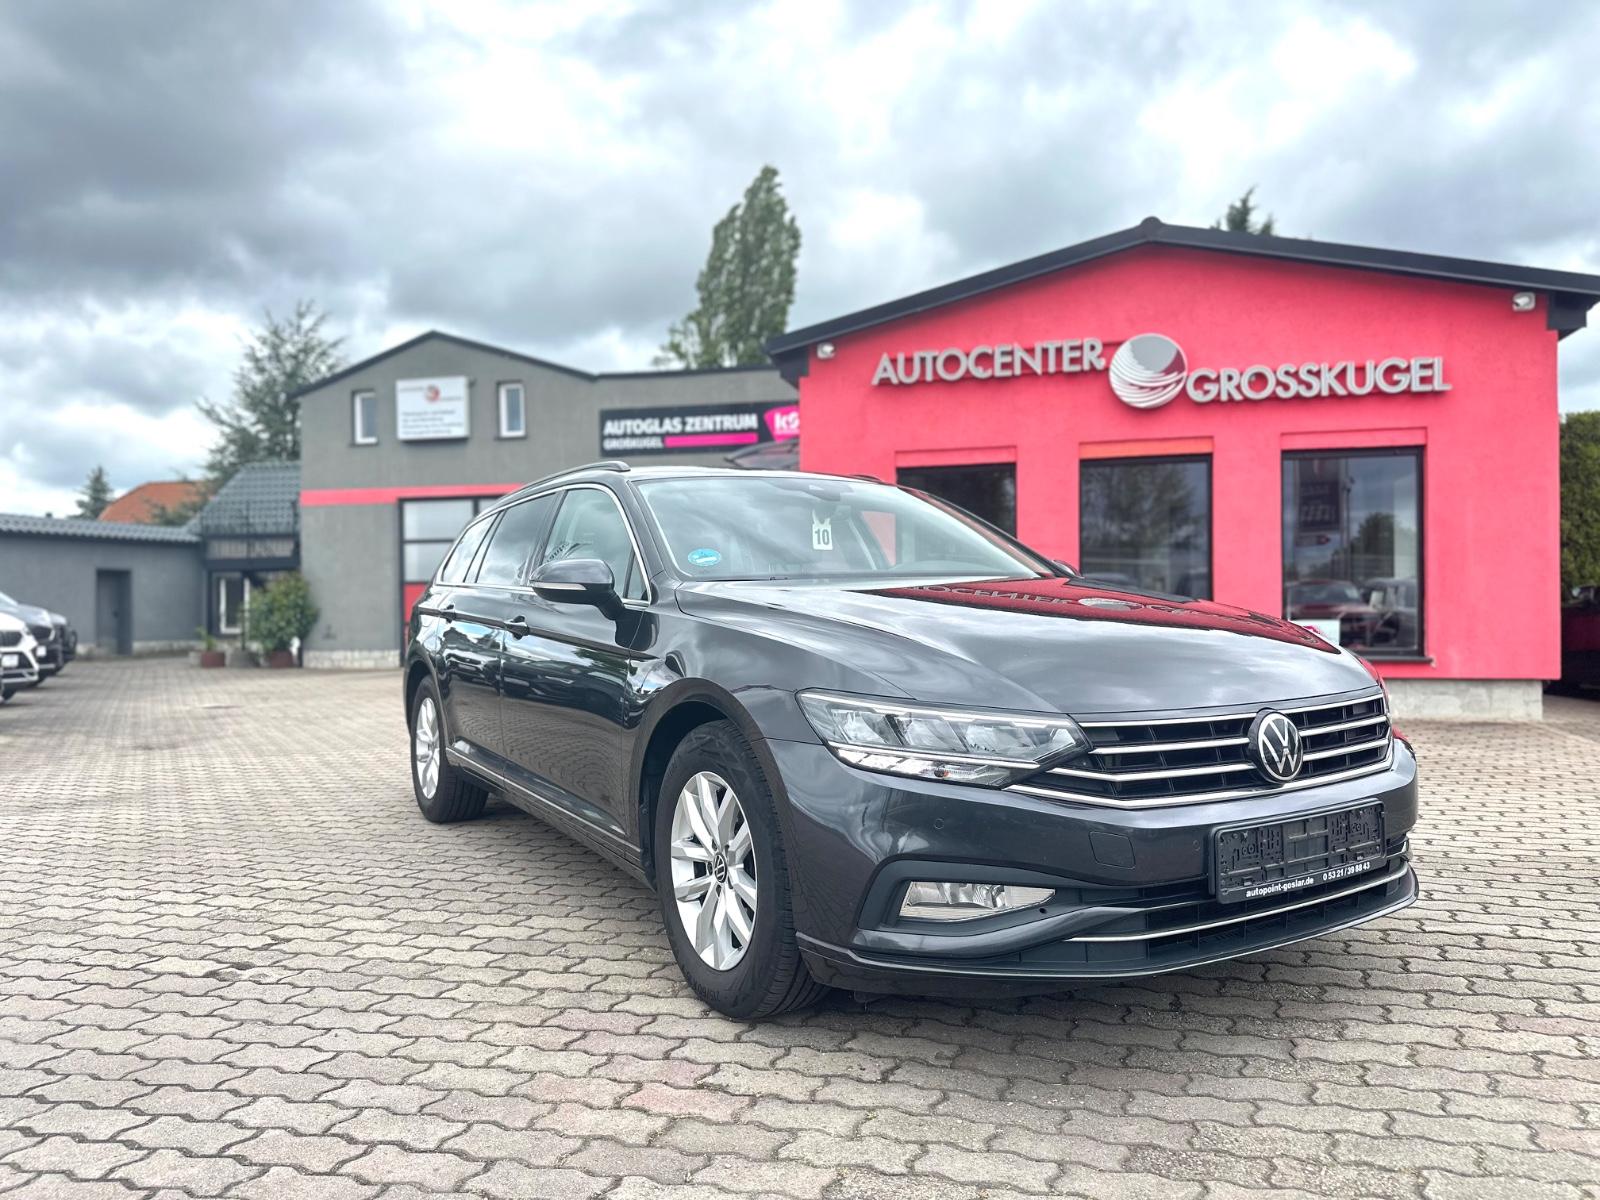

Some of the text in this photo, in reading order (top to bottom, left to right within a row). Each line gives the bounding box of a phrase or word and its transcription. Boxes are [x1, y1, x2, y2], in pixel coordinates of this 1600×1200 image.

[871, 337, 1453, 403] AUTOCENTER GROSSKUGEL
[603, 413, 758, 436] AUTOGLAS ZENTRUM
[814, 528, 830, 545] 10
[1246, 877, 1315, 897] autopoint-goslar.de
